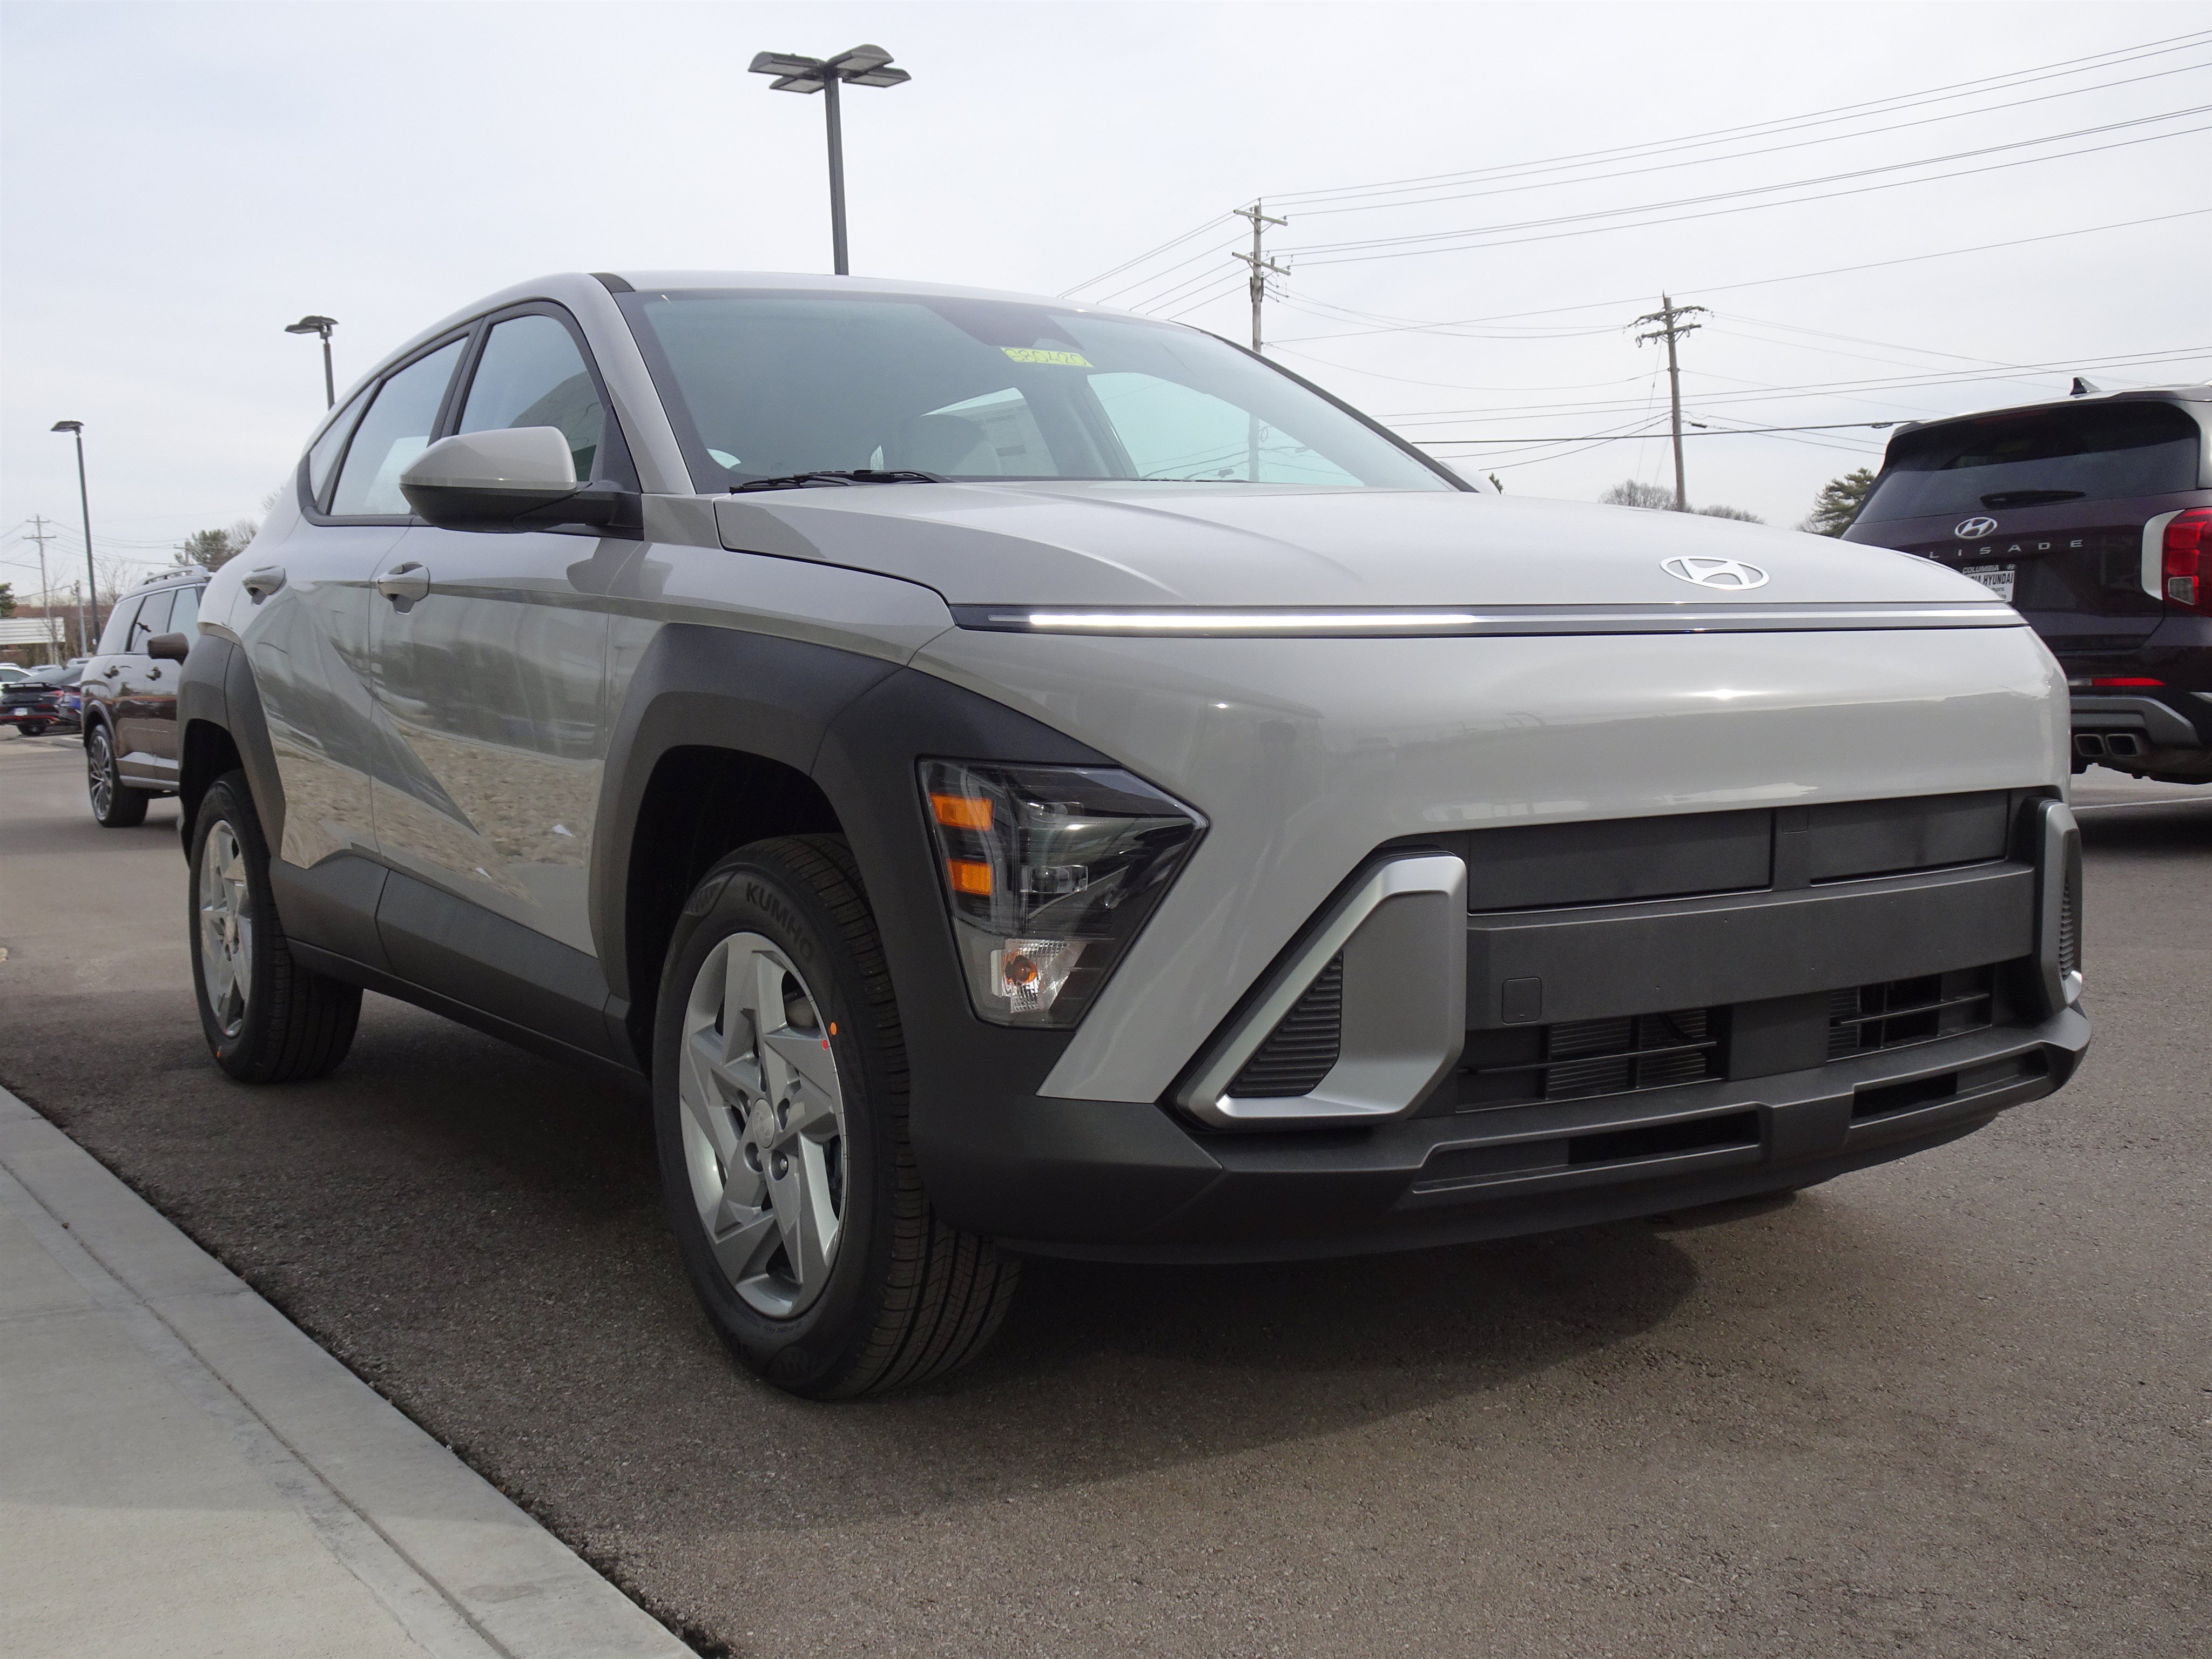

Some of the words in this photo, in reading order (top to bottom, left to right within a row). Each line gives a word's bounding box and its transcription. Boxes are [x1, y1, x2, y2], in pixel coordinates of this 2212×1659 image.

[1962, 565, 1999, 575] COLUMBIA
[1983, 573, 2013, 586] HYUNDAI
[746, 881, 812, 961] KUMHO
